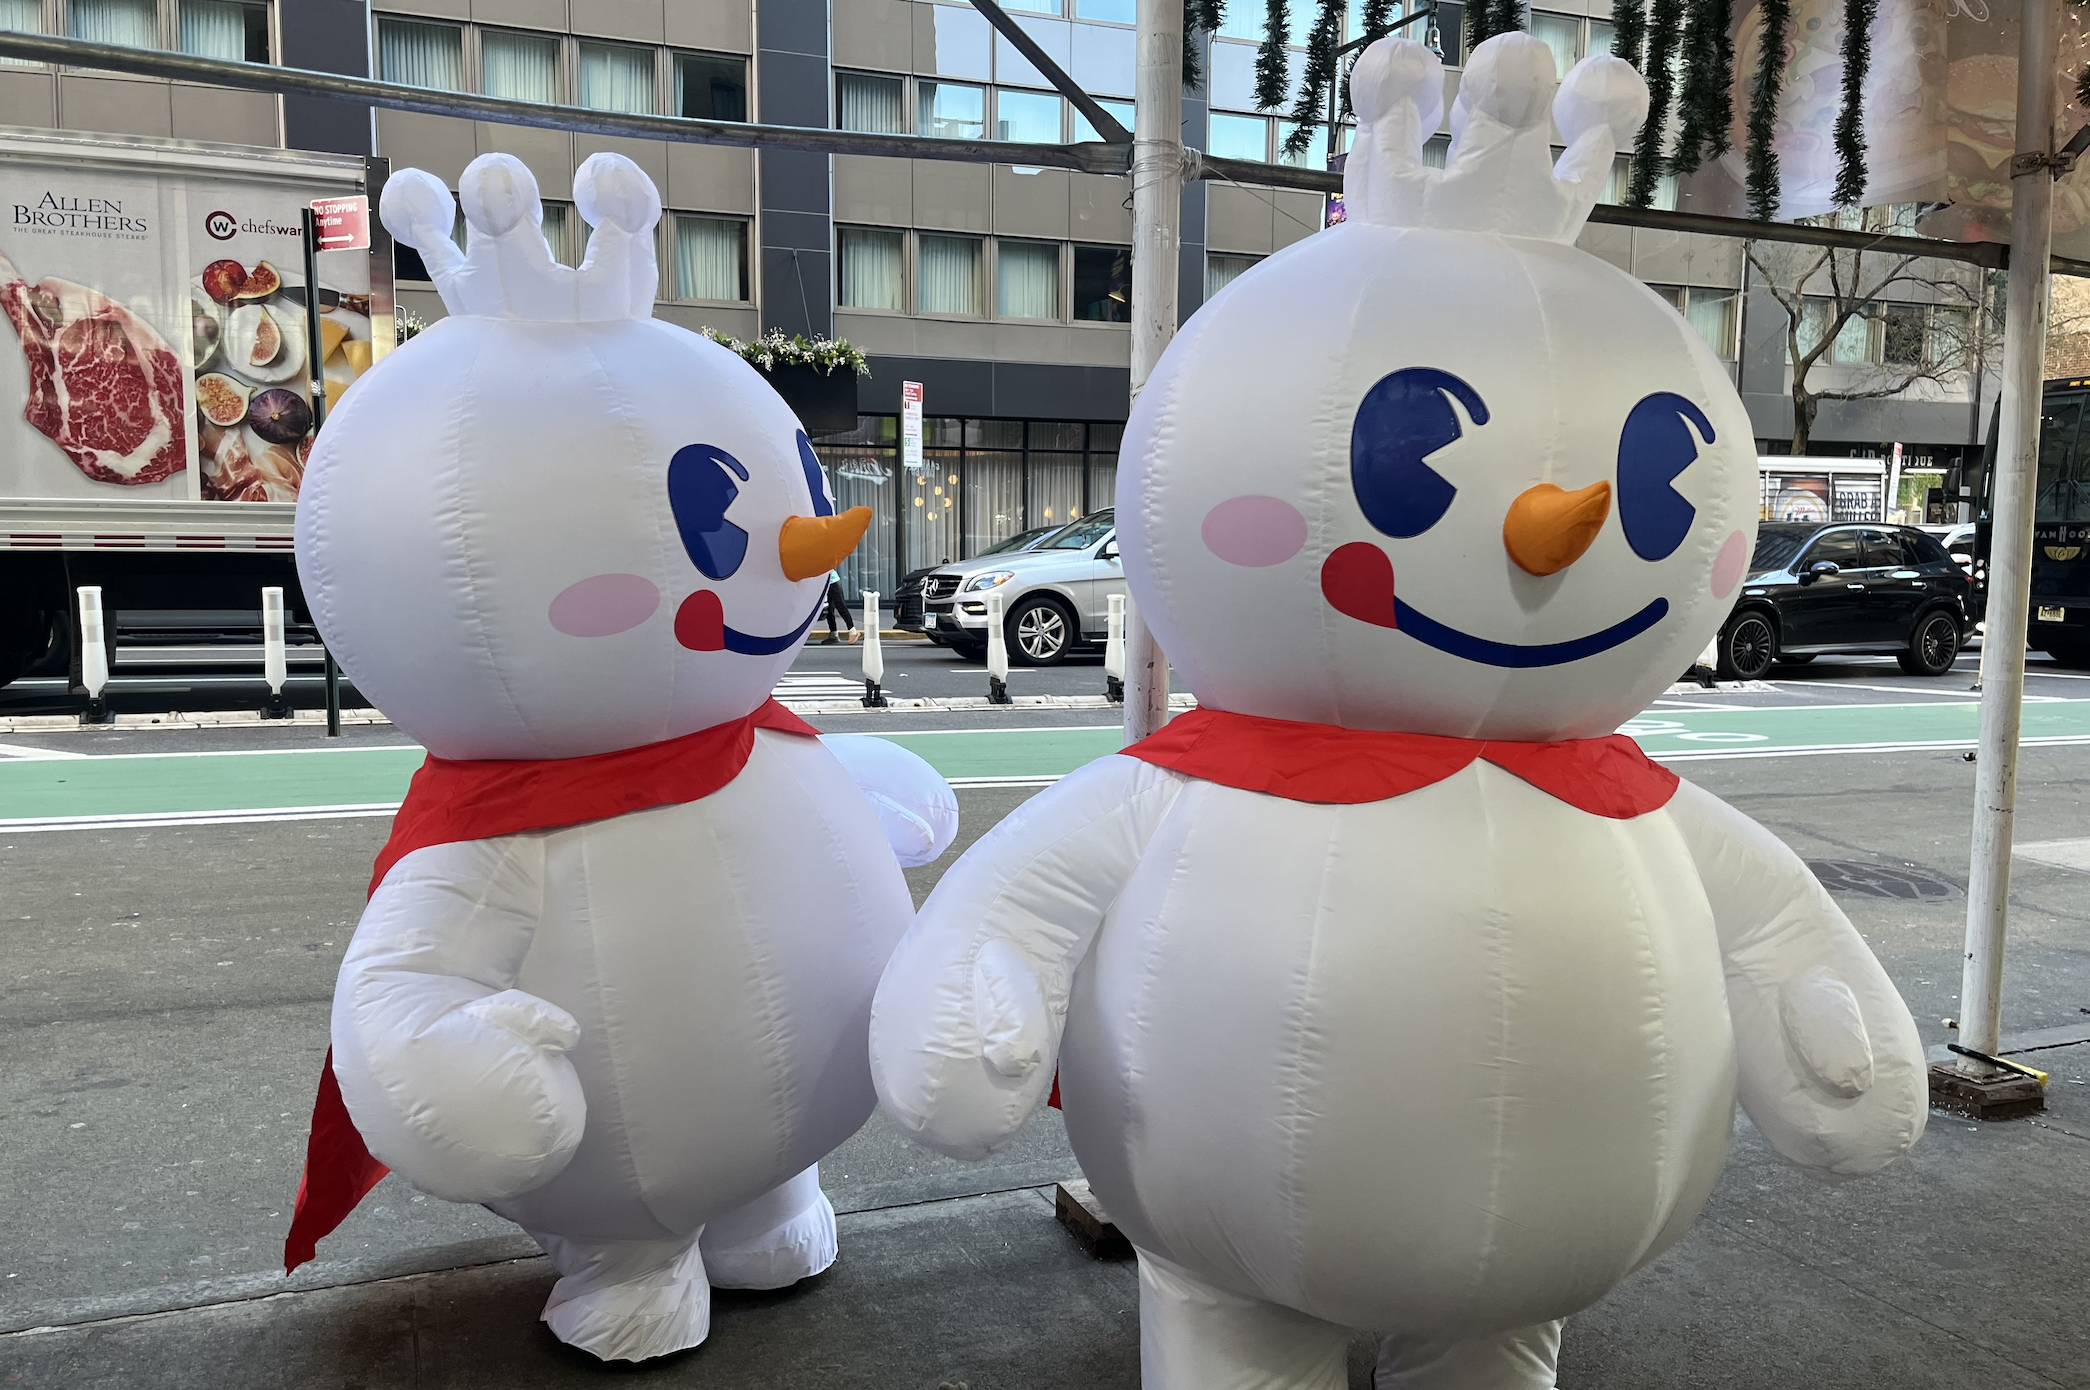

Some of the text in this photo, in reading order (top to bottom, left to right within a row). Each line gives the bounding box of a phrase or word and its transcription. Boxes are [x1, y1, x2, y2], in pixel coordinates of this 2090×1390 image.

[37, 191, 122, 213] ALLEN
[314, 203, 358, 215] NO STOPPING
[12, 204, 147, 232] BROTHERS
[241, 218, 303, 236] chefswar
[315, 217, 343, 228] Anytime
[60, 230, 112, 238] STEAKHOUSE
[1840, 491, 1868, 509] GRAB
